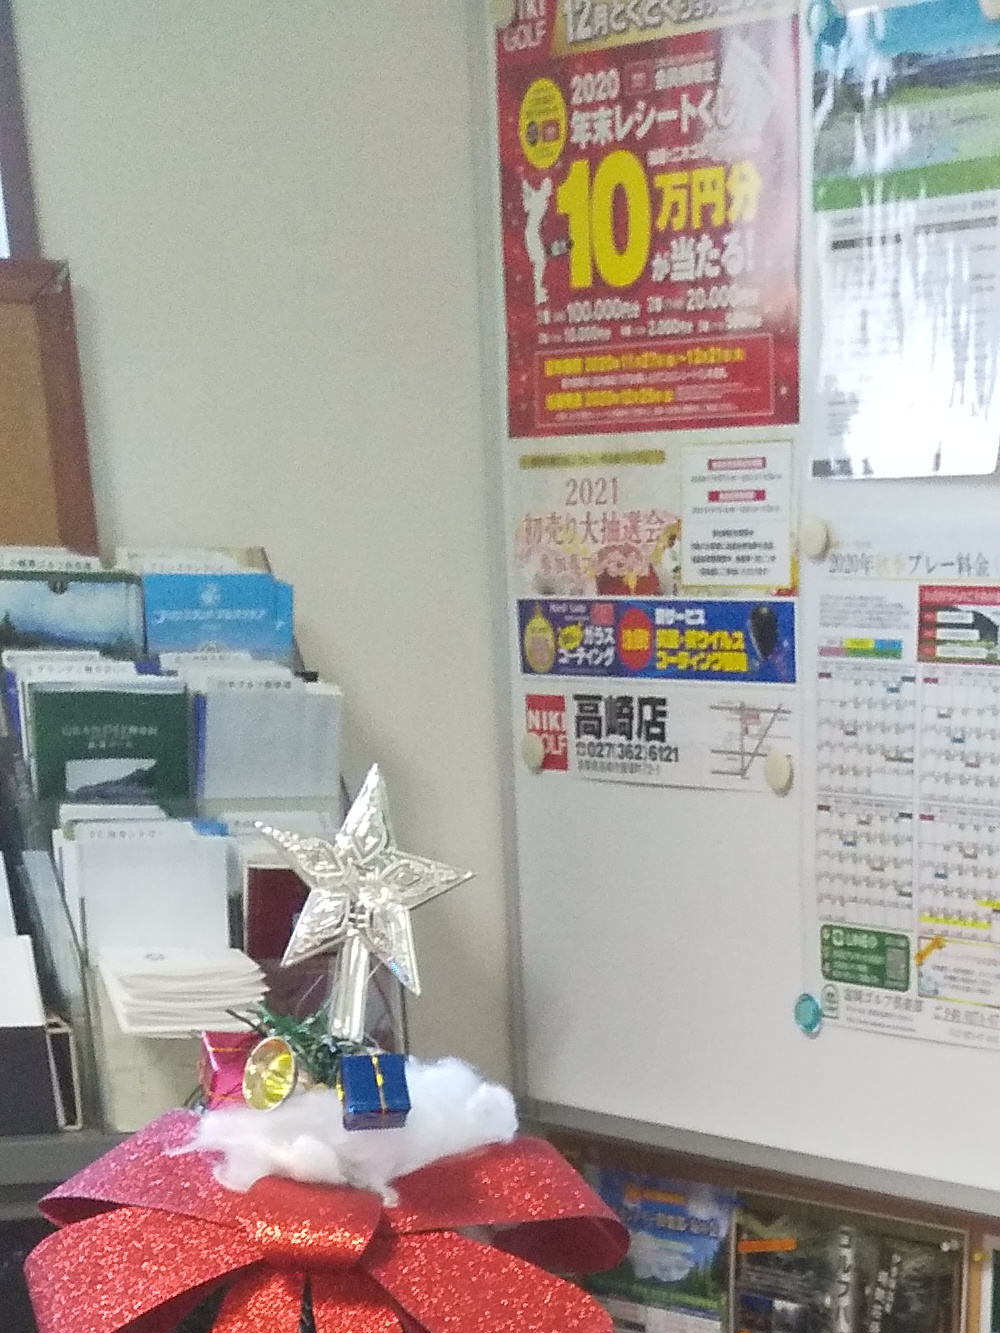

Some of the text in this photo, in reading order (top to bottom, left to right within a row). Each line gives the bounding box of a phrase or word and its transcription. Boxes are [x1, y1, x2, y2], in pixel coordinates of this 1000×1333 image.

[570, 68, 620, 105] 2020
[565, 477, 620, 507] 2021
[572, 693, 668, 744] 高崎店
